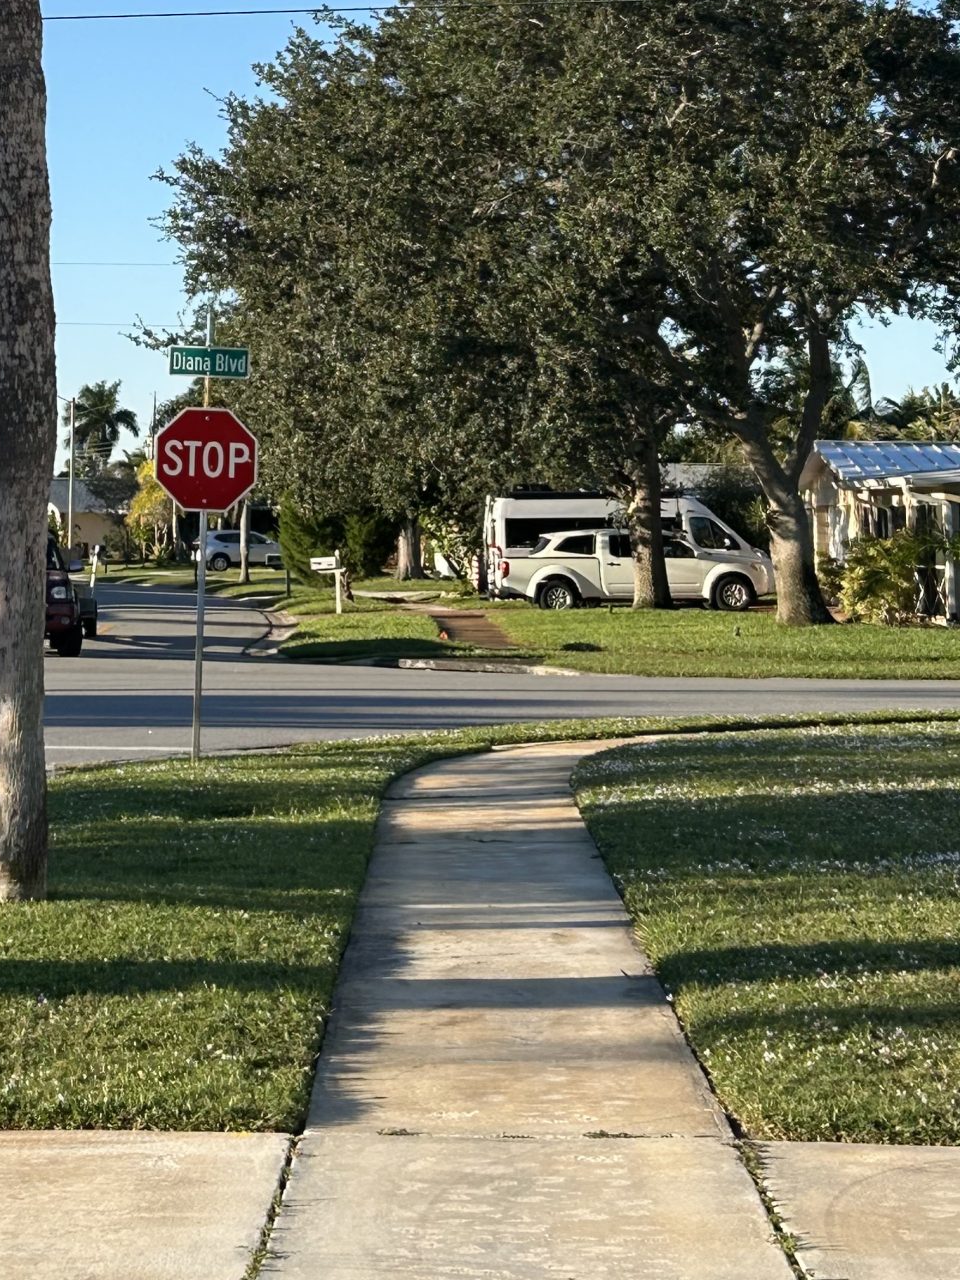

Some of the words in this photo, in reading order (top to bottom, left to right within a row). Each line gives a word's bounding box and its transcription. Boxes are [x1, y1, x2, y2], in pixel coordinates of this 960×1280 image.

[173, 352, 211, 371] Diana
[216, 354, 246, 372] Blvd
[163, 440, 251, 478] STOP
